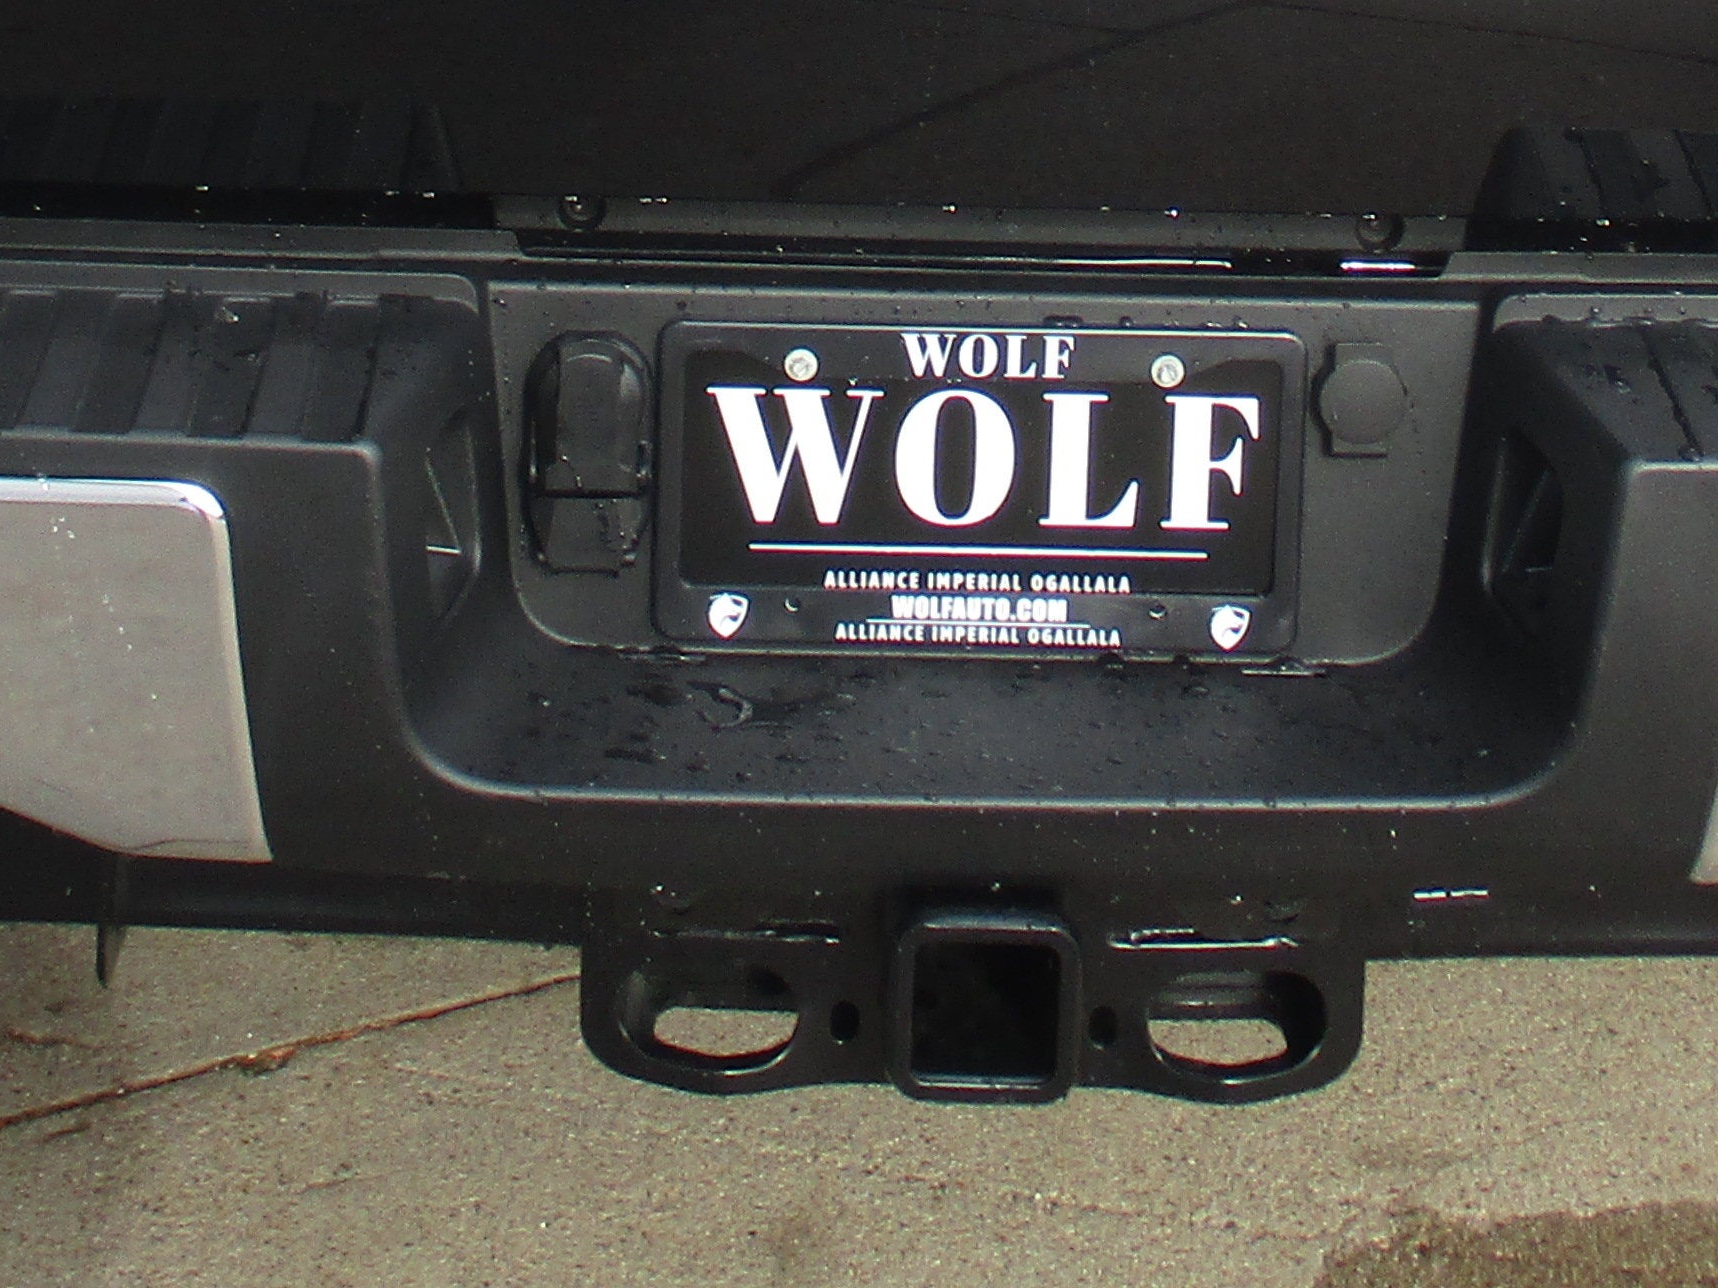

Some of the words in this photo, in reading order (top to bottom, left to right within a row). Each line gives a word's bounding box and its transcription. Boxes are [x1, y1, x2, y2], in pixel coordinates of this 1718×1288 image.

[901, 332, 1075, 379] WOLF
[706, 386, 1261, 530] WOLF
[824, 570, 920, 590] ALLIANCE
[928, 572, 1022, 592] IMPERIAL
[1030, 574, 1131, 594] OGALLALA
[891, 595, 1068, 623] WOLFAUTO.COM
[835, 623, 925, 642] ALLIANCE
[932, 626, 1020, 644] IMPERIAL
[1027, 627, 1122, 647] OGALLALA
